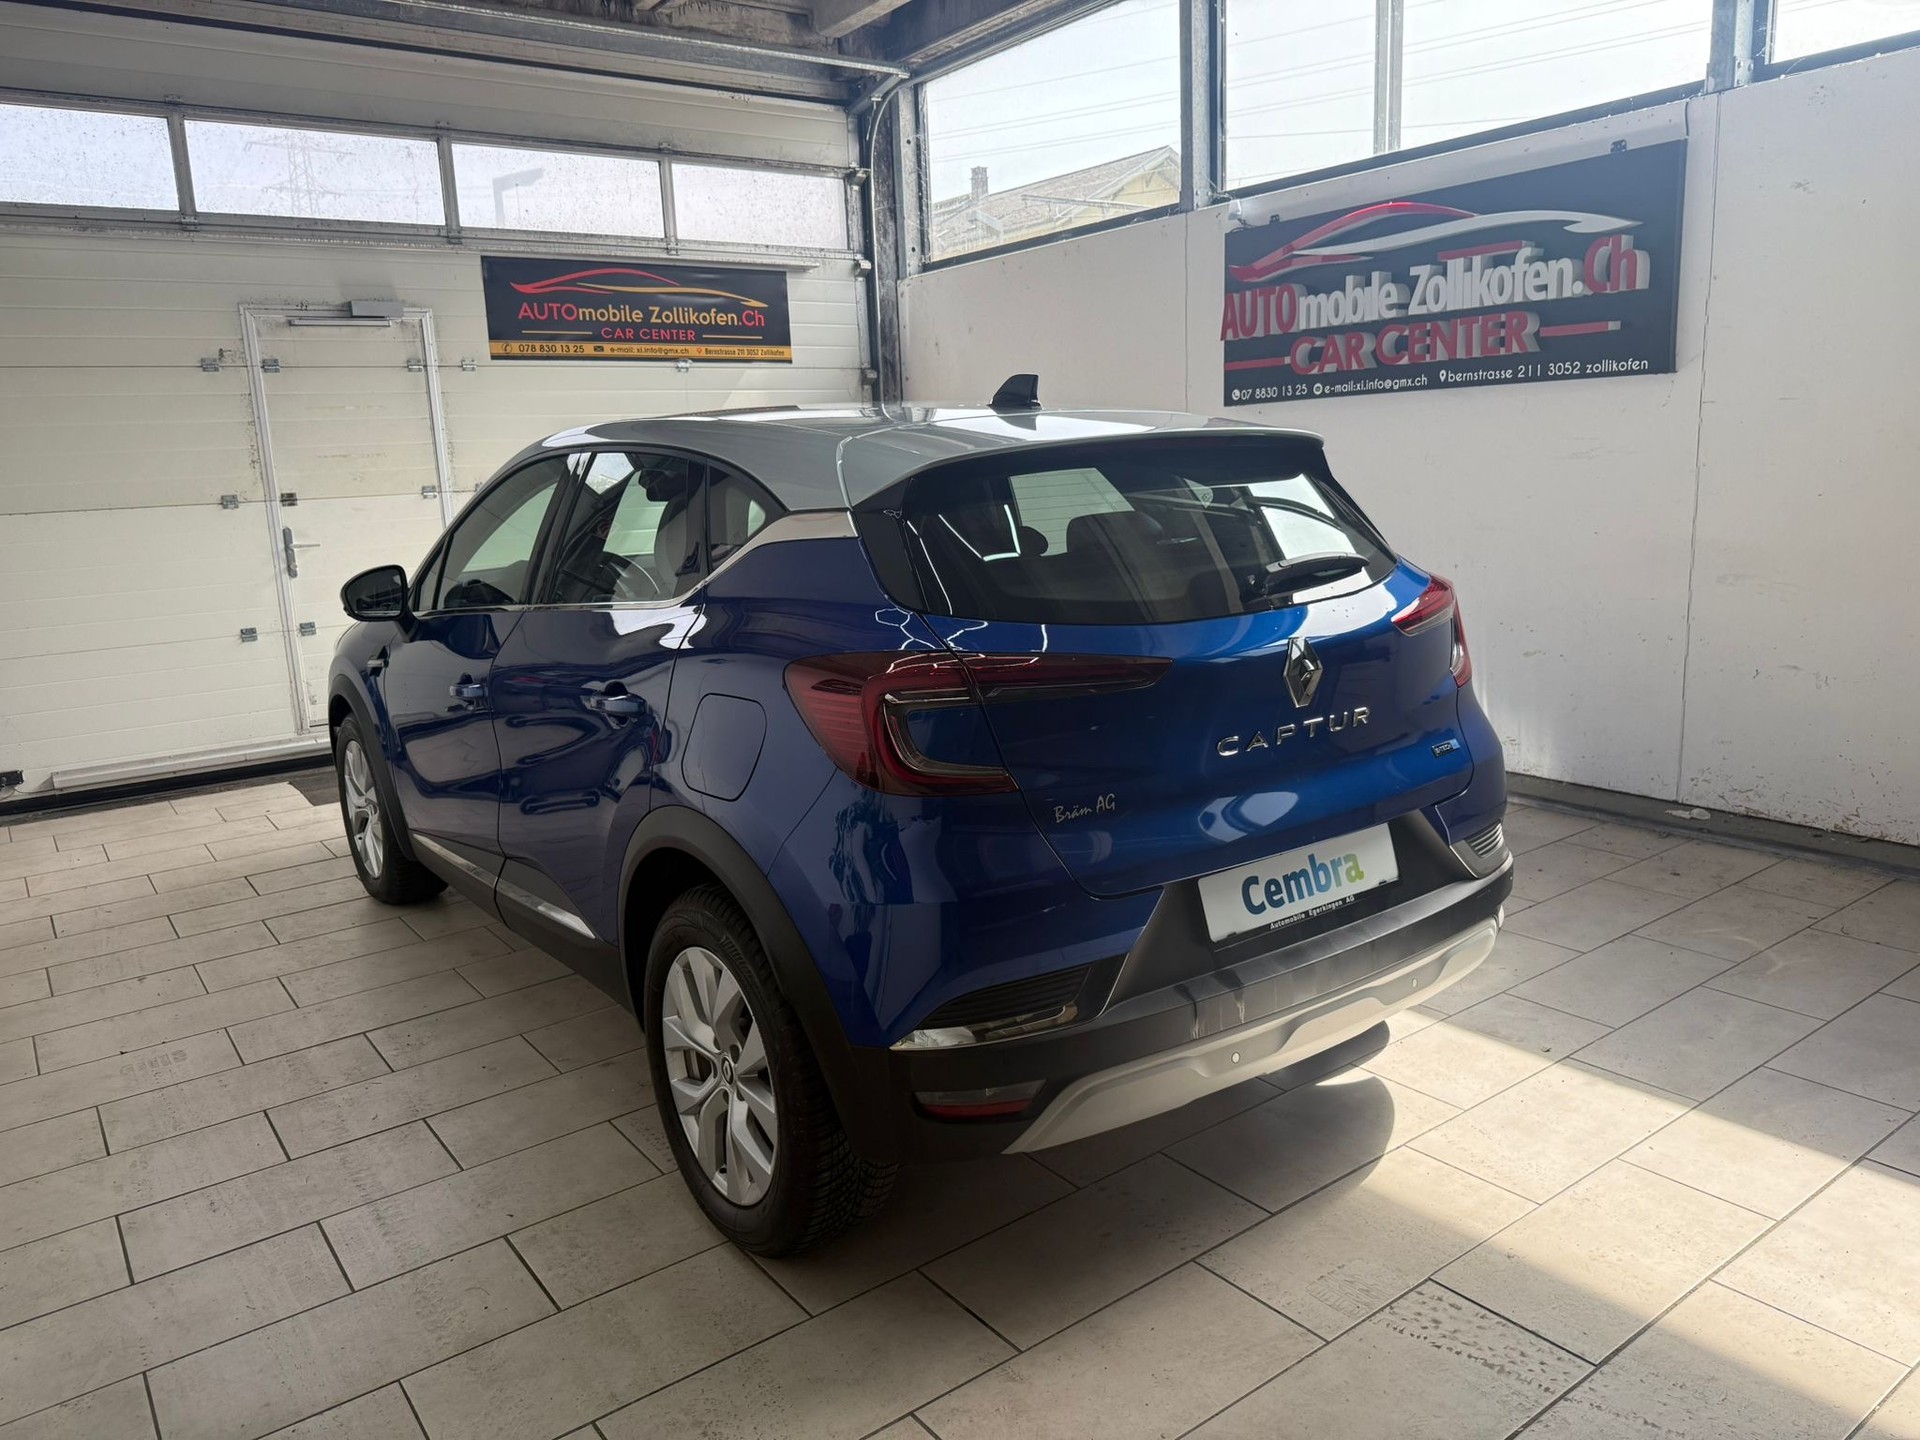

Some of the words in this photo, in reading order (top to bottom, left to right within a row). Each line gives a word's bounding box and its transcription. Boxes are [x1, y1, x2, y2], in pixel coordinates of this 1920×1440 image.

[517, 302, 644, 323] AUTOmobile
[650, 305, 765, 327] Zollikofen.Ch
[518, 343, 537, 353] 078
[539, 344, 557, 353] 830
[560, 344, 571, 353] 13
[573, 344, 585, 353] 25
[601, 327, 634, 340] CAR
[639, 328, 696, 341] CENTER
[1290, 332, 1375, 375] CAR
[1375, 311, 1539, 366] CENTER
[1240, 389, 1251, 400] 07
[1255, 387, 1278, 399] 8830
[1282, 385, 1292, 396] 13
[1295, 384, 1308, 395] 25
[1448, 368, 1513, 382] bernstrasse
[1517, 364, 1541, 378] 211
[1547, 361, 1581, 376] 3052
[1586, 358, 1649, 374] zollikofen
[1217, 706, 1370, 757] CAPTUR
[1053, 804, 1093, 823] Bräm
[1096, 793, 1115, 814] AG
[1241, 853, 1365, 915] Cembra
[1270, 913, 1306, 930] Automobile
[1345, 895, 1355, 904] AG
